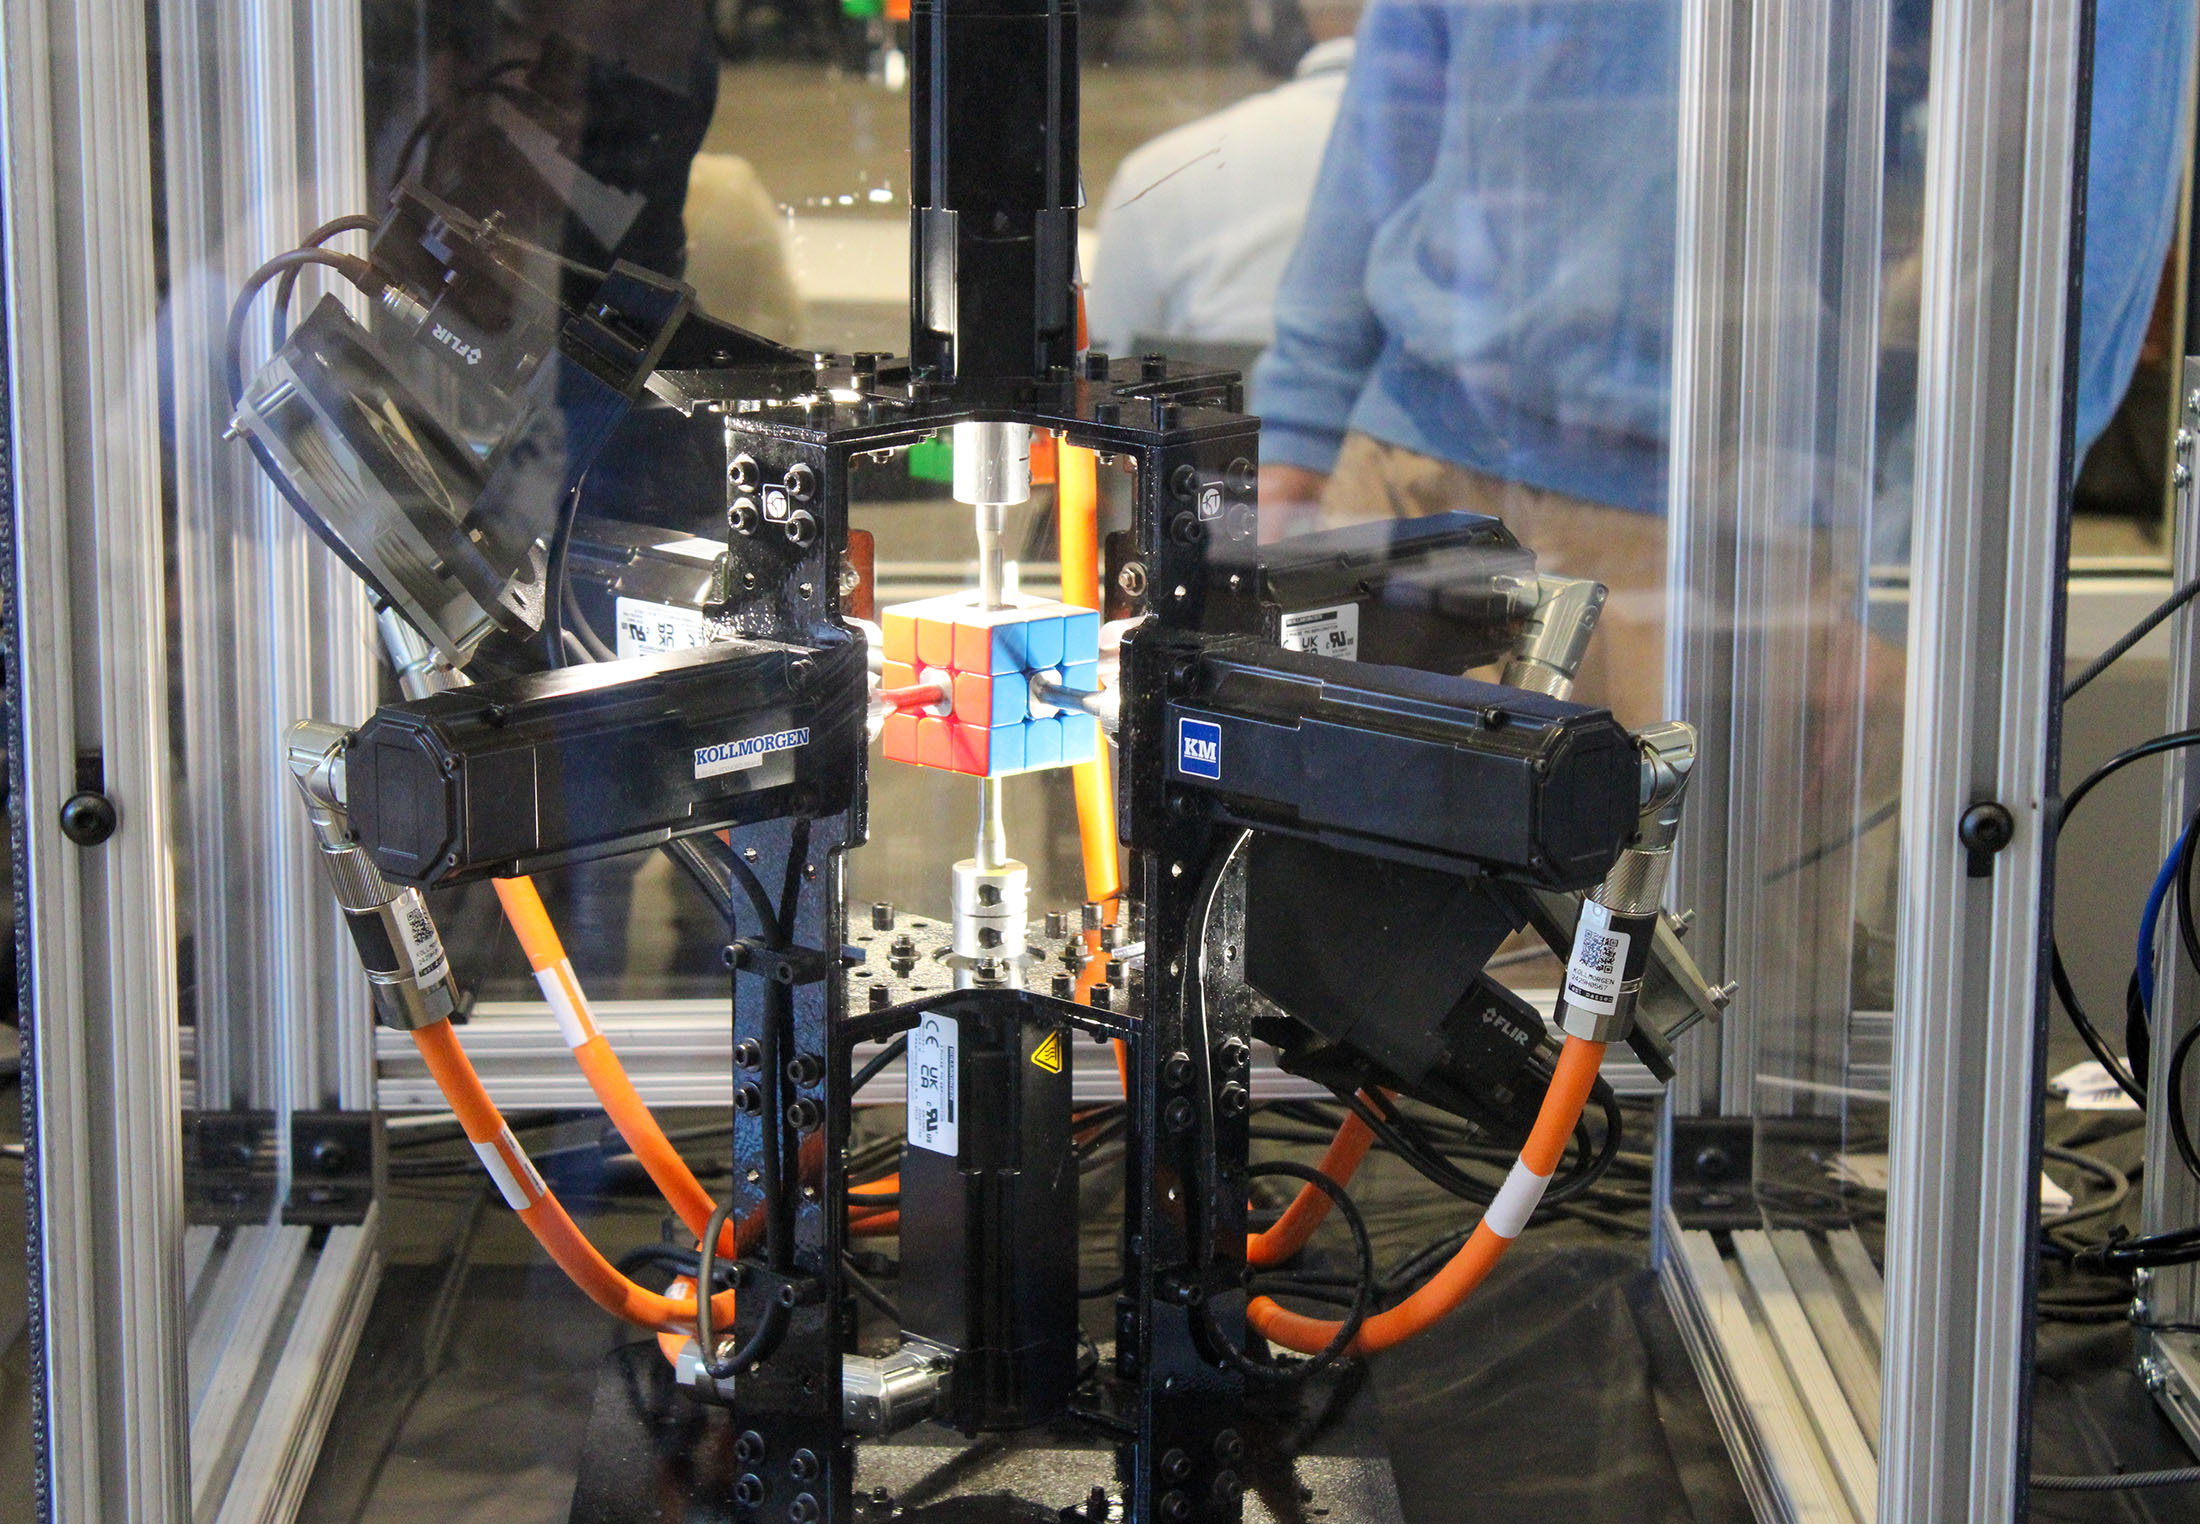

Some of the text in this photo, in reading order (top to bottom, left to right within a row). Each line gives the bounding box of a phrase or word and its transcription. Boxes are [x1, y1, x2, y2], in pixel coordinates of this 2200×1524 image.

[431, 322, 470, 357] FLIR
[1302, 635, 1318, 649] UK
[696, 728, 809, 766] KOLLMORGEN
[1183, 736, 1217, 761] KM
[1573, 967, 1615, 985] KOLLMORGEN
[1493, 1015, 1529, 1047] FLIR
